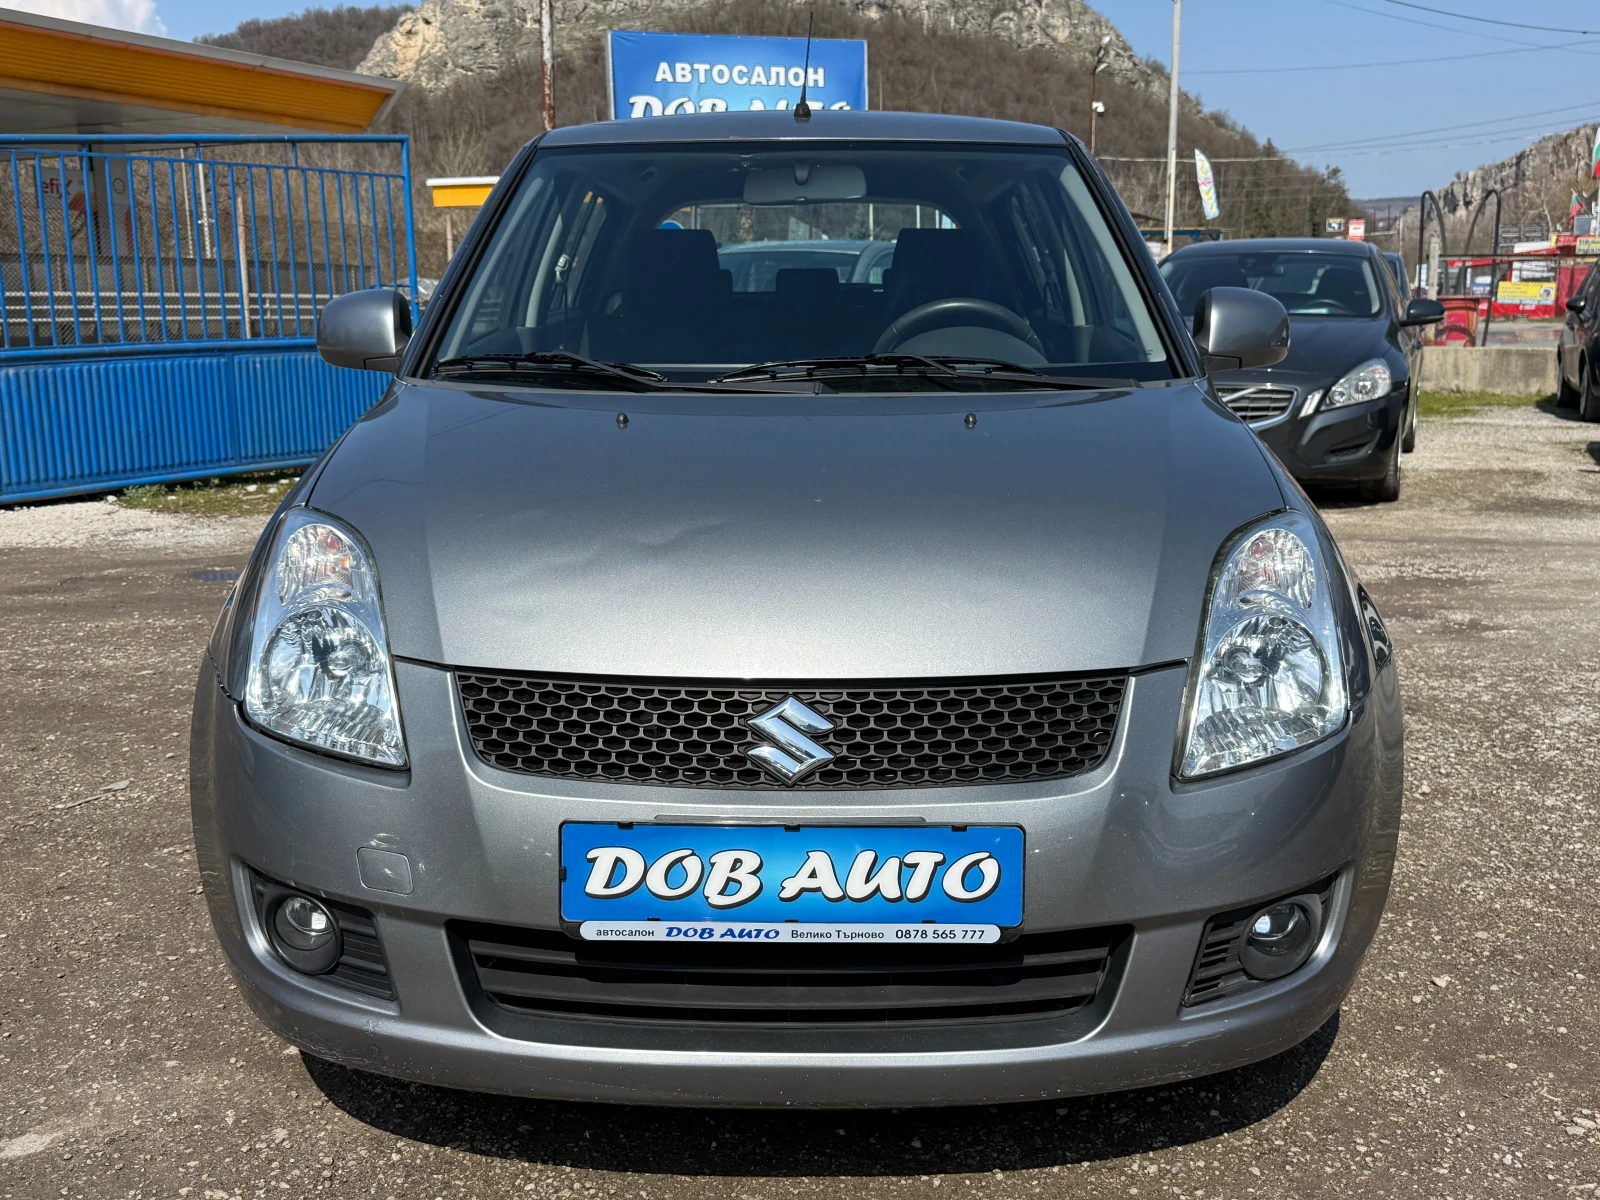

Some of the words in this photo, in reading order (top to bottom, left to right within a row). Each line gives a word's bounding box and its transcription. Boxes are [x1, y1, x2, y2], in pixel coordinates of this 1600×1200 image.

[654, 61, 825, 88] АВТОСАЛОН
[585, 846, 764, 909] DOB
[777, 850, 1000, 903] AUTO
[596, 929, 655, 938] автосалон
[665, 926, 715, 940] DOB
[719, 927, 780, 940] AUTO
[791, 930, 832, 939] Велико
[834, 930, 885, 941] Търново
[895, 930, 928, 940] 0878
[932, 930, 957, 940] 565
[961, 930, 985, 940] 777
